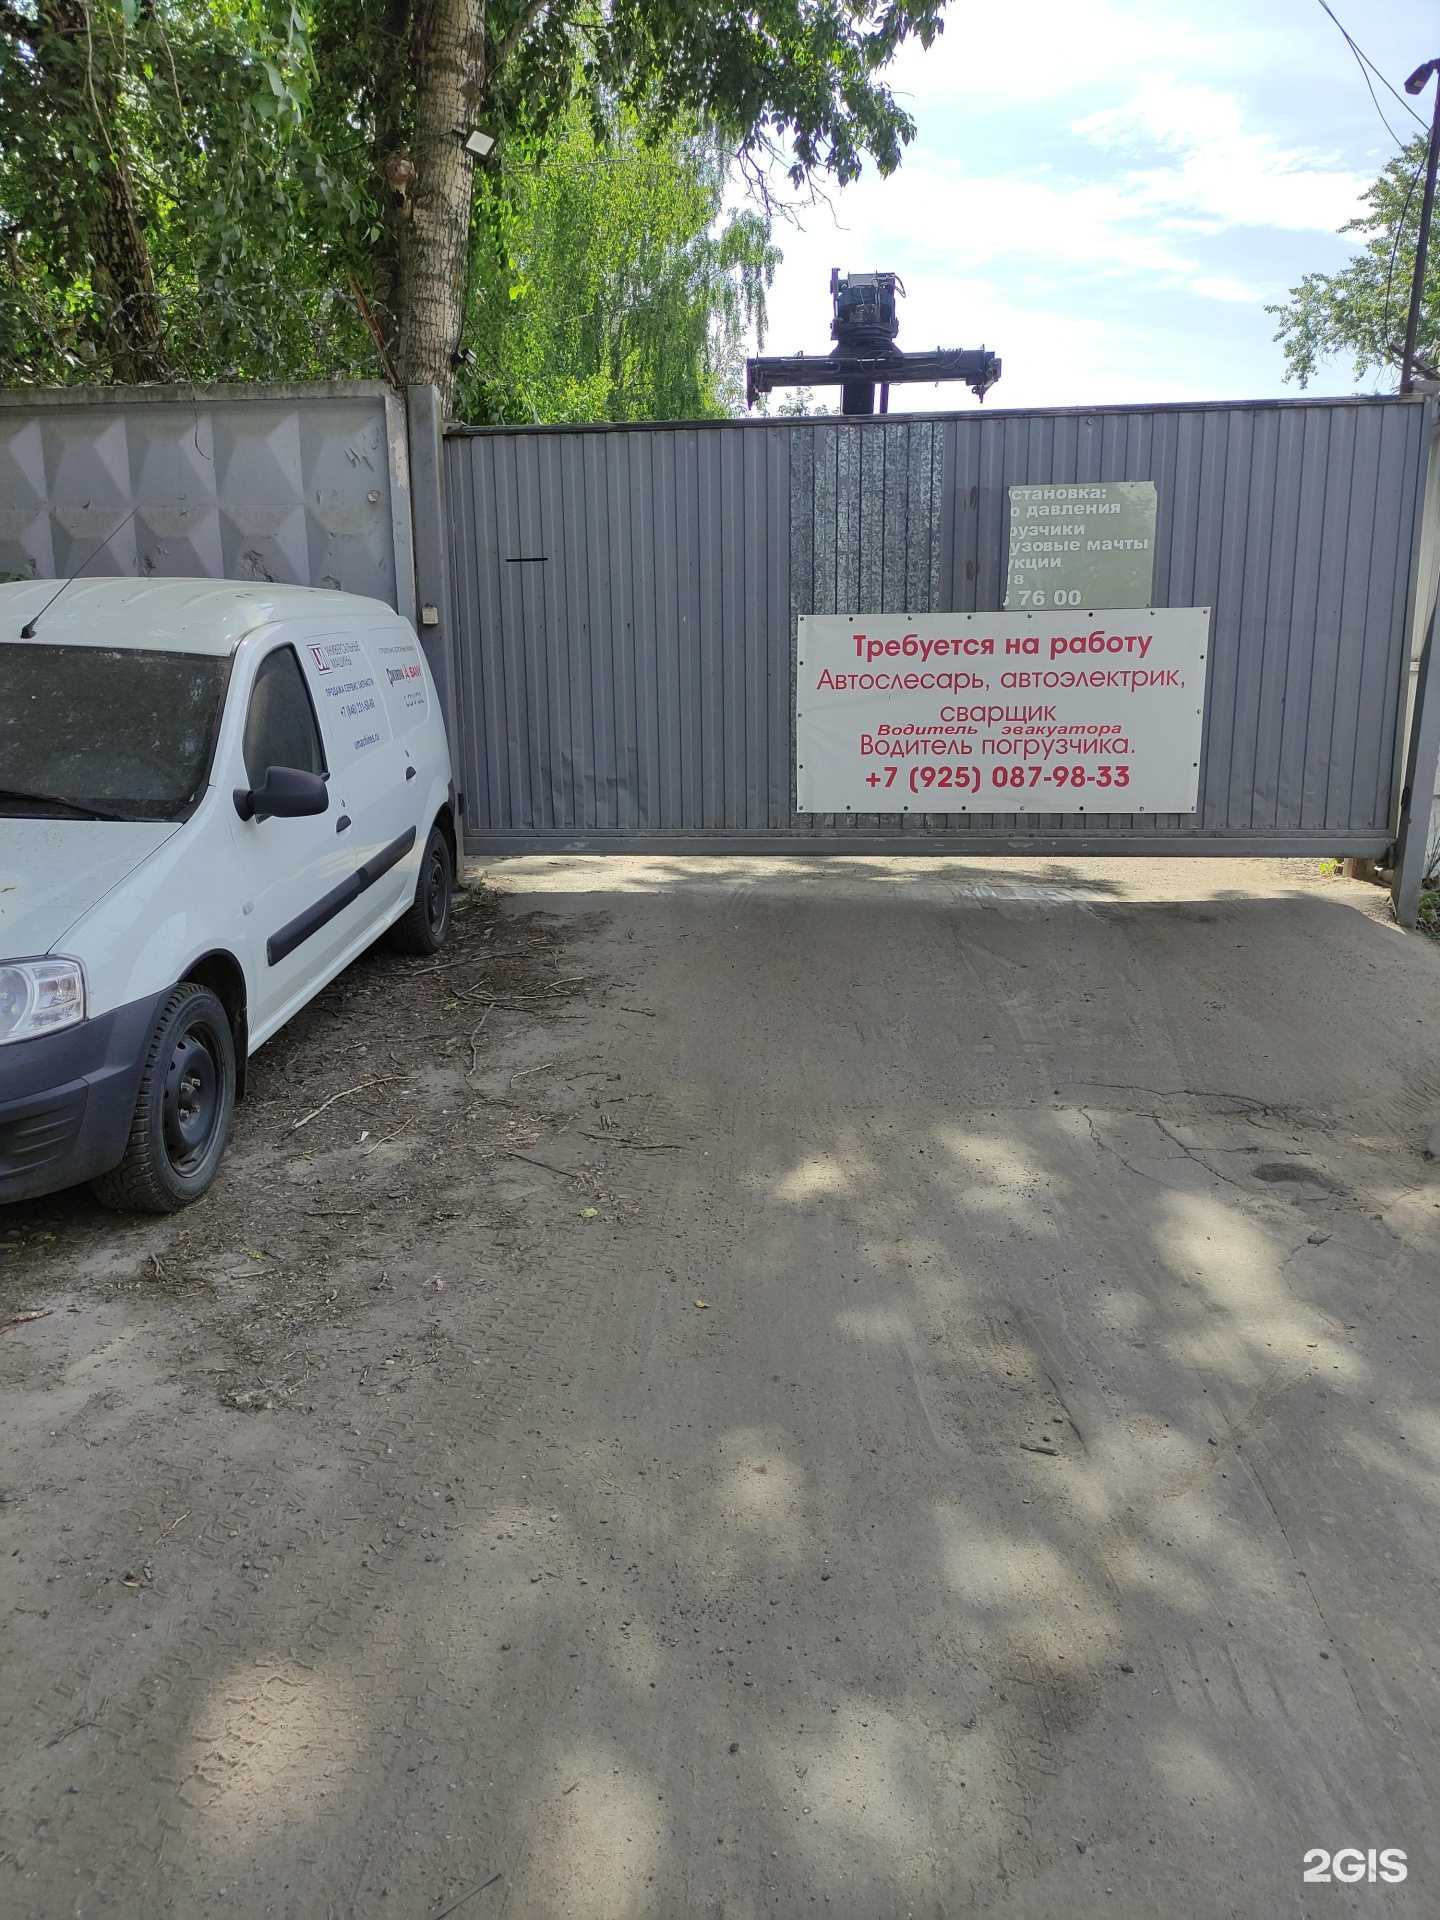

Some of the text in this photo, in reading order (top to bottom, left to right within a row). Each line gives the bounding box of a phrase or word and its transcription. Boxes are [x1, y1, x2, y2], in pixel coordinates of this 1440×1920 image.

[1026, 502, 1121, 518] давления
[1087, 537, 1149, 552] мачты
[1017, 590, 1046, 606] 76
[1053, 589, 1082, 606] 00
[853, 631, 1153, 662] Требуется на работу
[816, 666, 1186, 694] Автослесарь, автоэлектрик,
[940, 704, 1057, 727] сварщик
[877, 723, 1122, 737] Водитель эвакуатора
[860, 735, 1136, 761] Водитель погрузчика.
[865, 765, 1131, 793] +7 (925) 087-98-33
